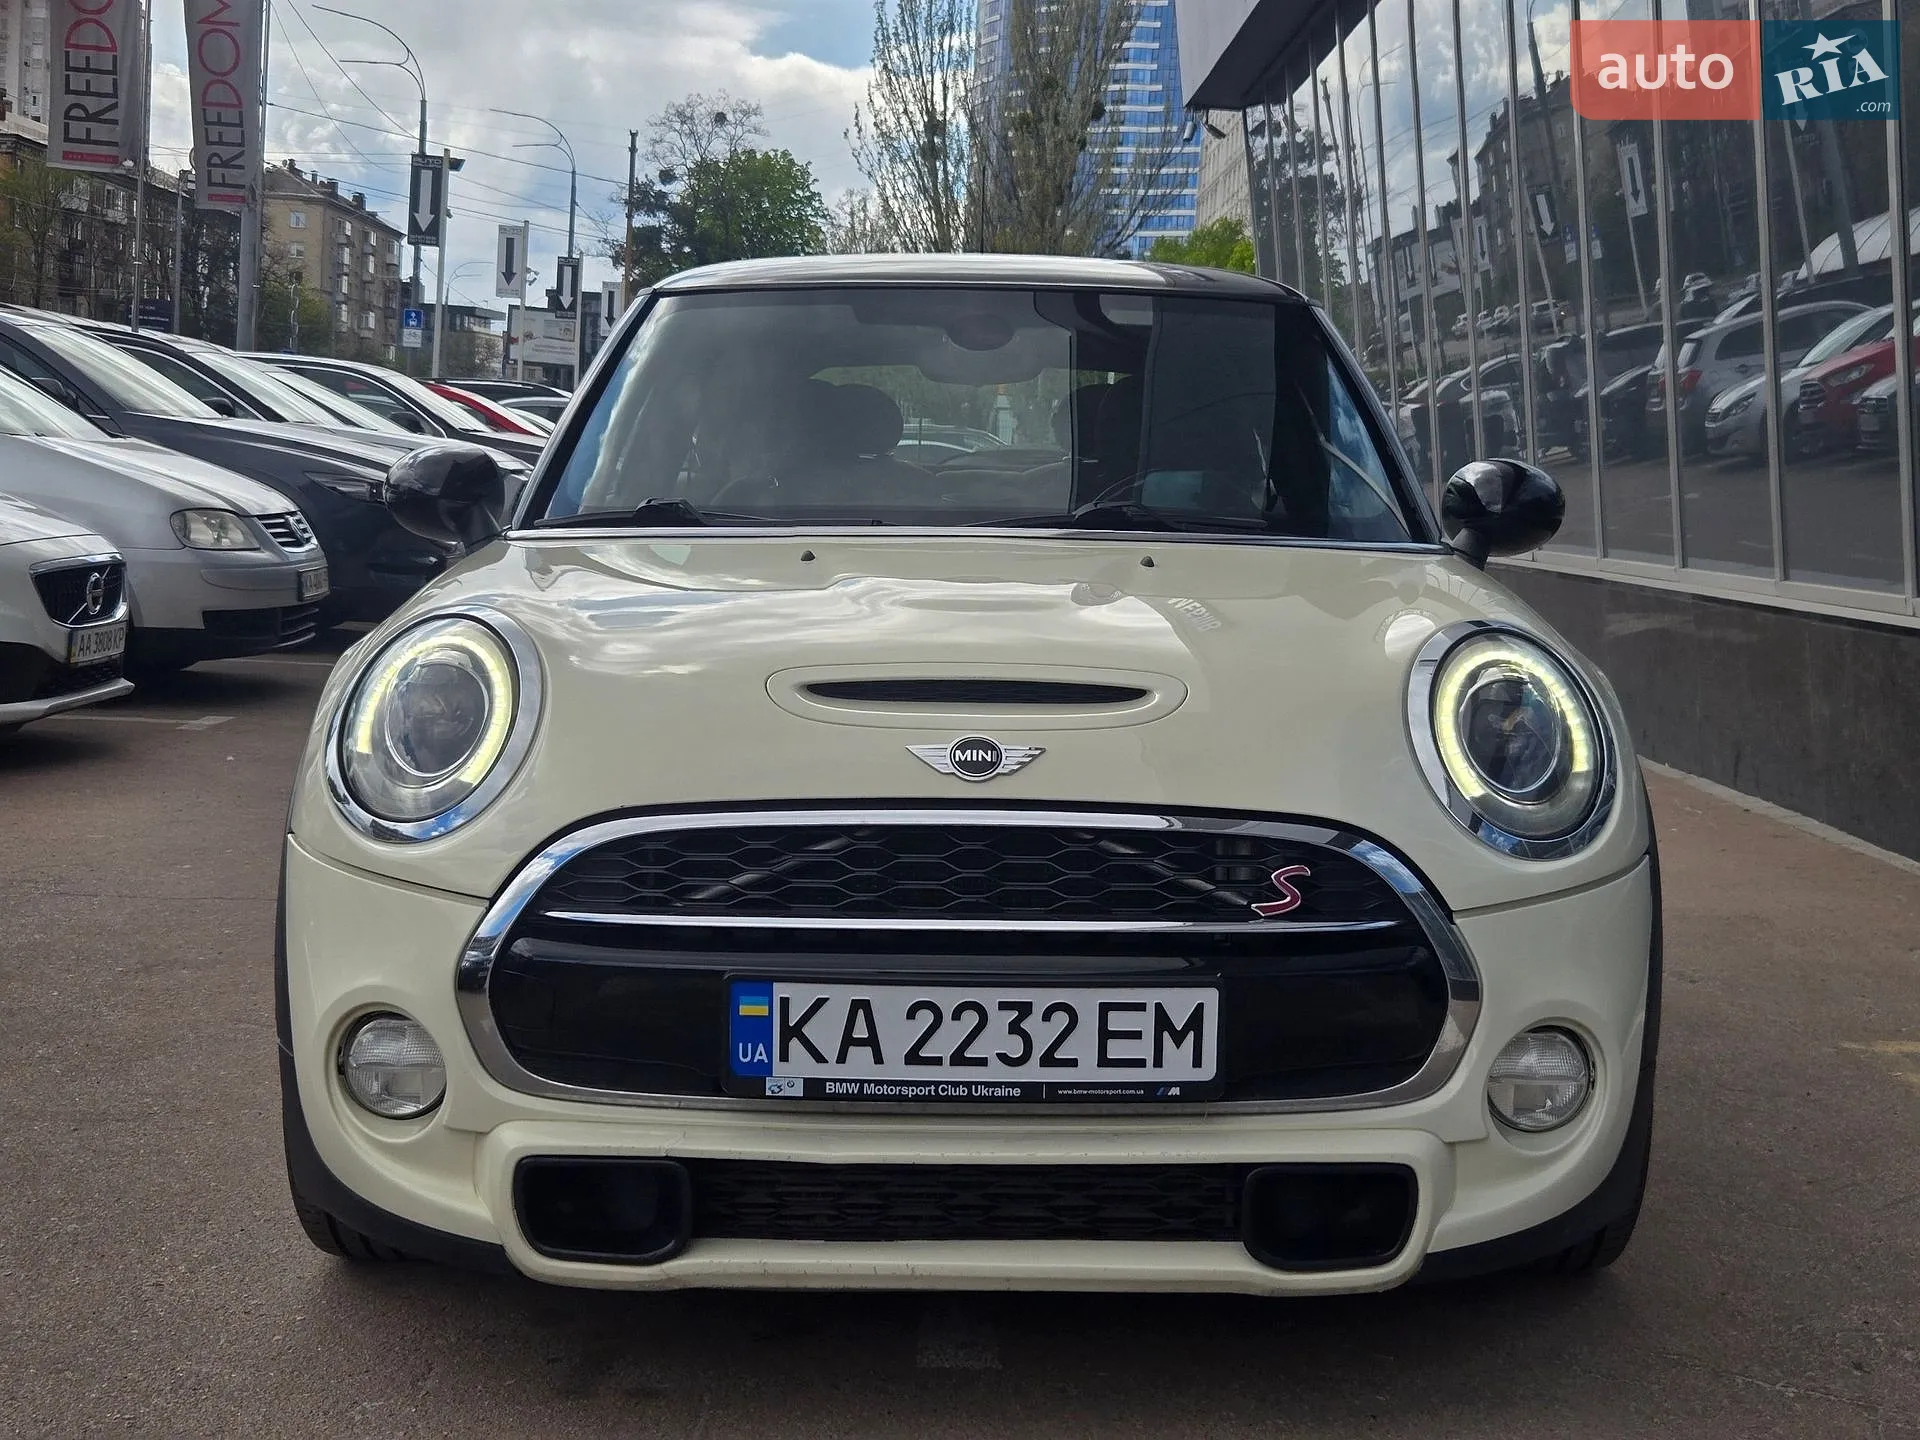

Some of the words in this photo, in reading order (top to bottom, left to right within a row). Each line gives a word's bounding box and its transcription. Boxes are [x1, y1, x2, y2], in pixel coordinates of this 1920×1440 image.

[955, 749, 997, 762] MINI
[1251, 865, 1311, 917] S
[778, 996, 885, 1064] KA
[904, 999, 1079, 1068] 2232
[1097, 1001, 1204, 1068] EM
[739, 1042, 768, 1063] UA
[825, 1082, 859, 1094] BMW
[864, 1082, 936, 1098] Motorsport
[938, 1083, 968, 1096] Club
[972, 1083, 1021, 1097] Ukraine
[1057, 1087, 1145, 1097] www.bmw-motorsport.com.ua
